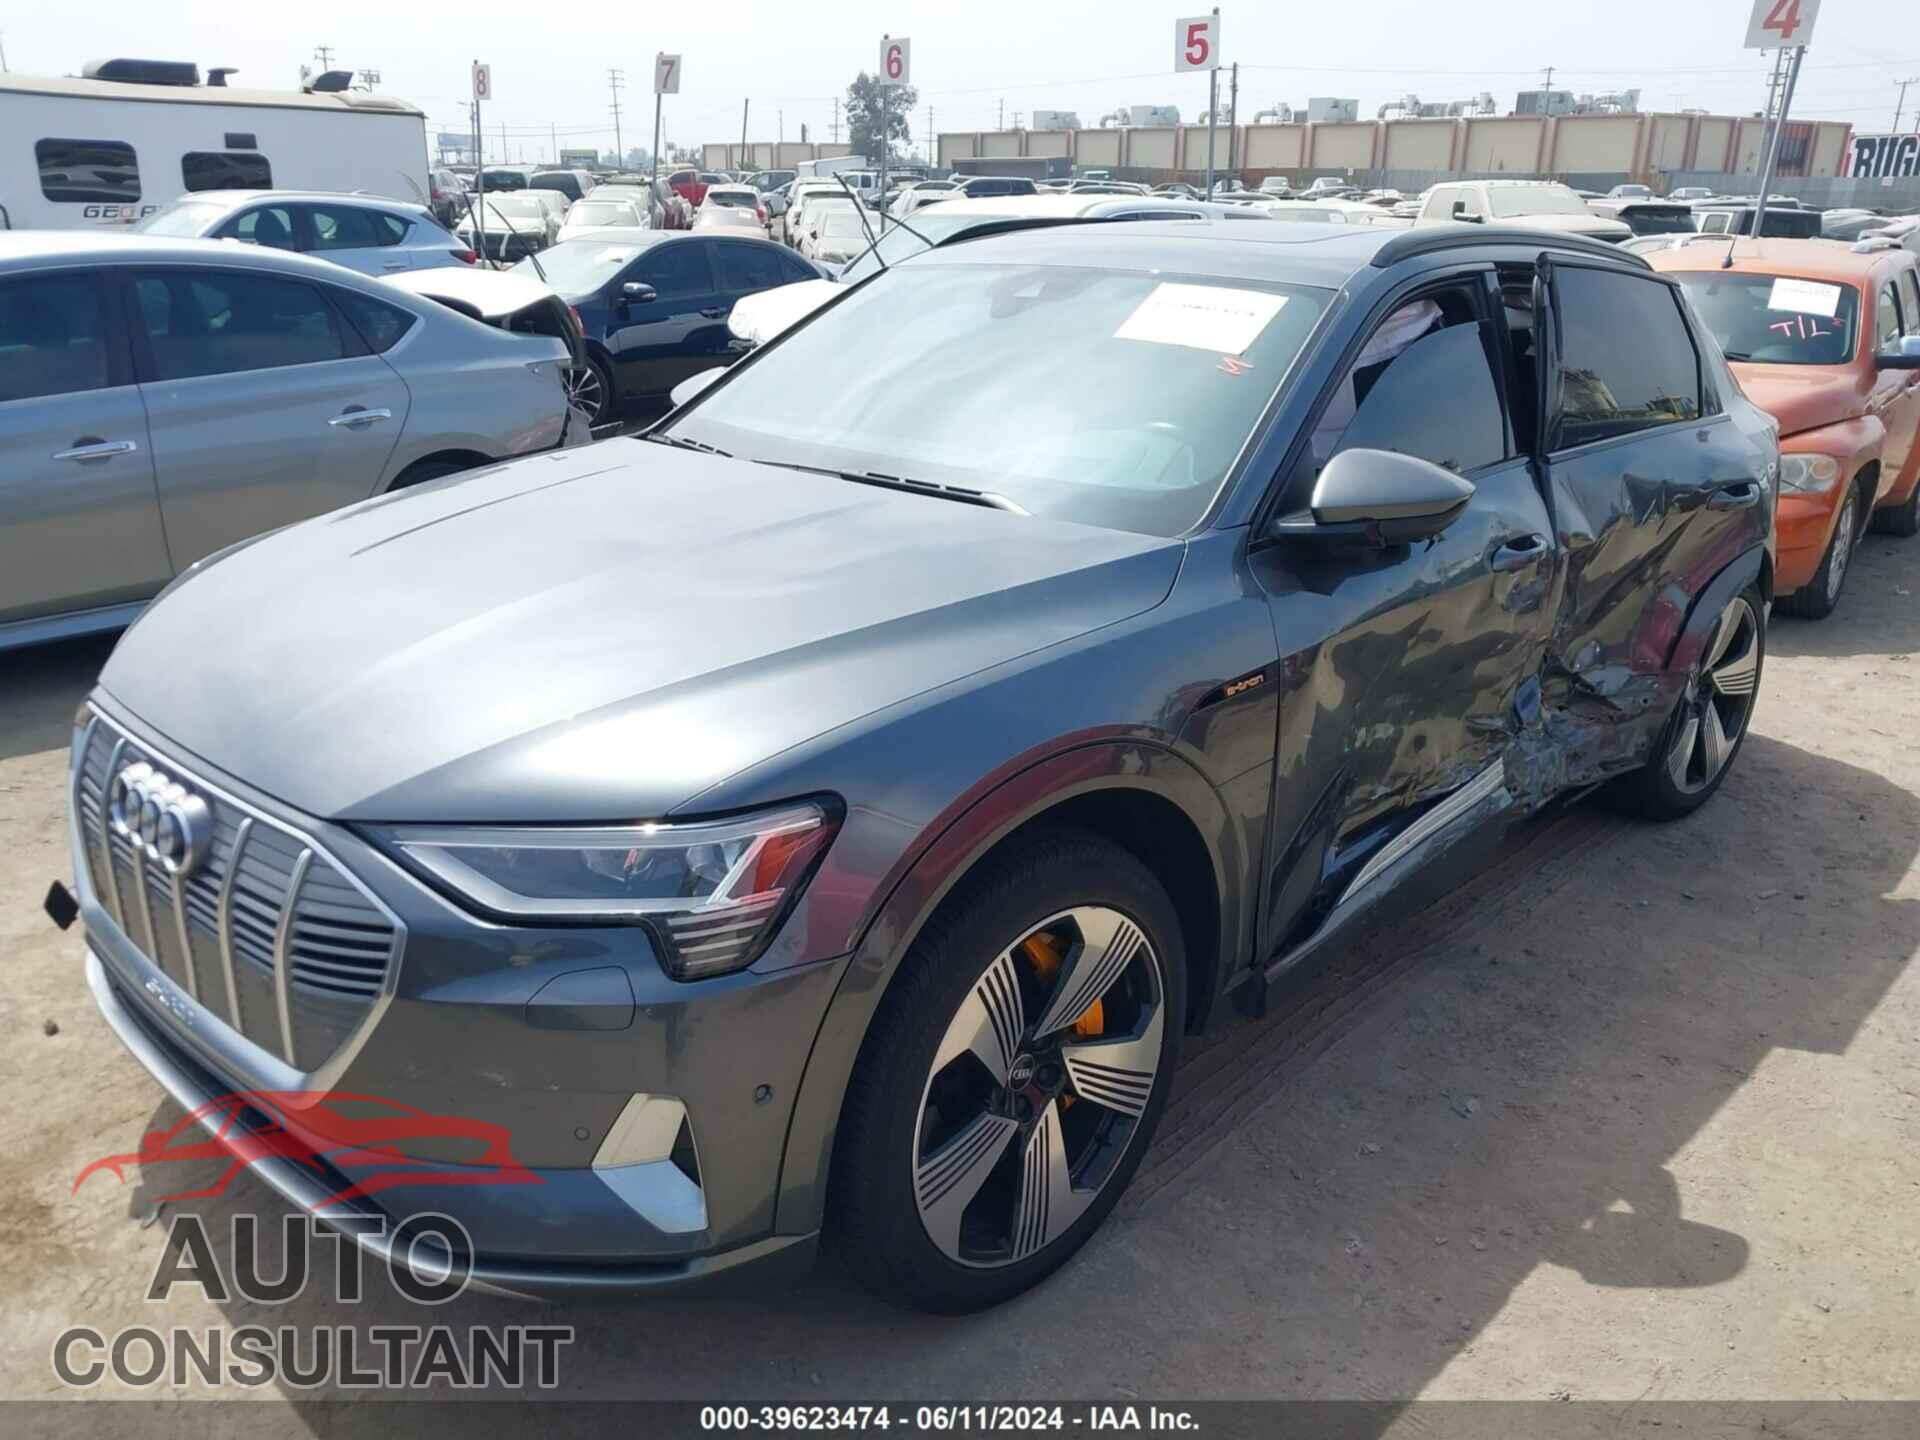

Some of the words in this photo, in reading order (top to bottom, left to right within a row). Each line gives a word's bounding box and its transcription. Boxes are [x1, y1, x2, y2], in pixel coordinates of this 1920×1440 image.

[1762, 0, 1800, 39] 4
[886, 44, 903, 79] 6
[1185, 23, 1210, 66] 5
[476, 68, 487, 96] 8
[661, 59, 676, 89] 7
